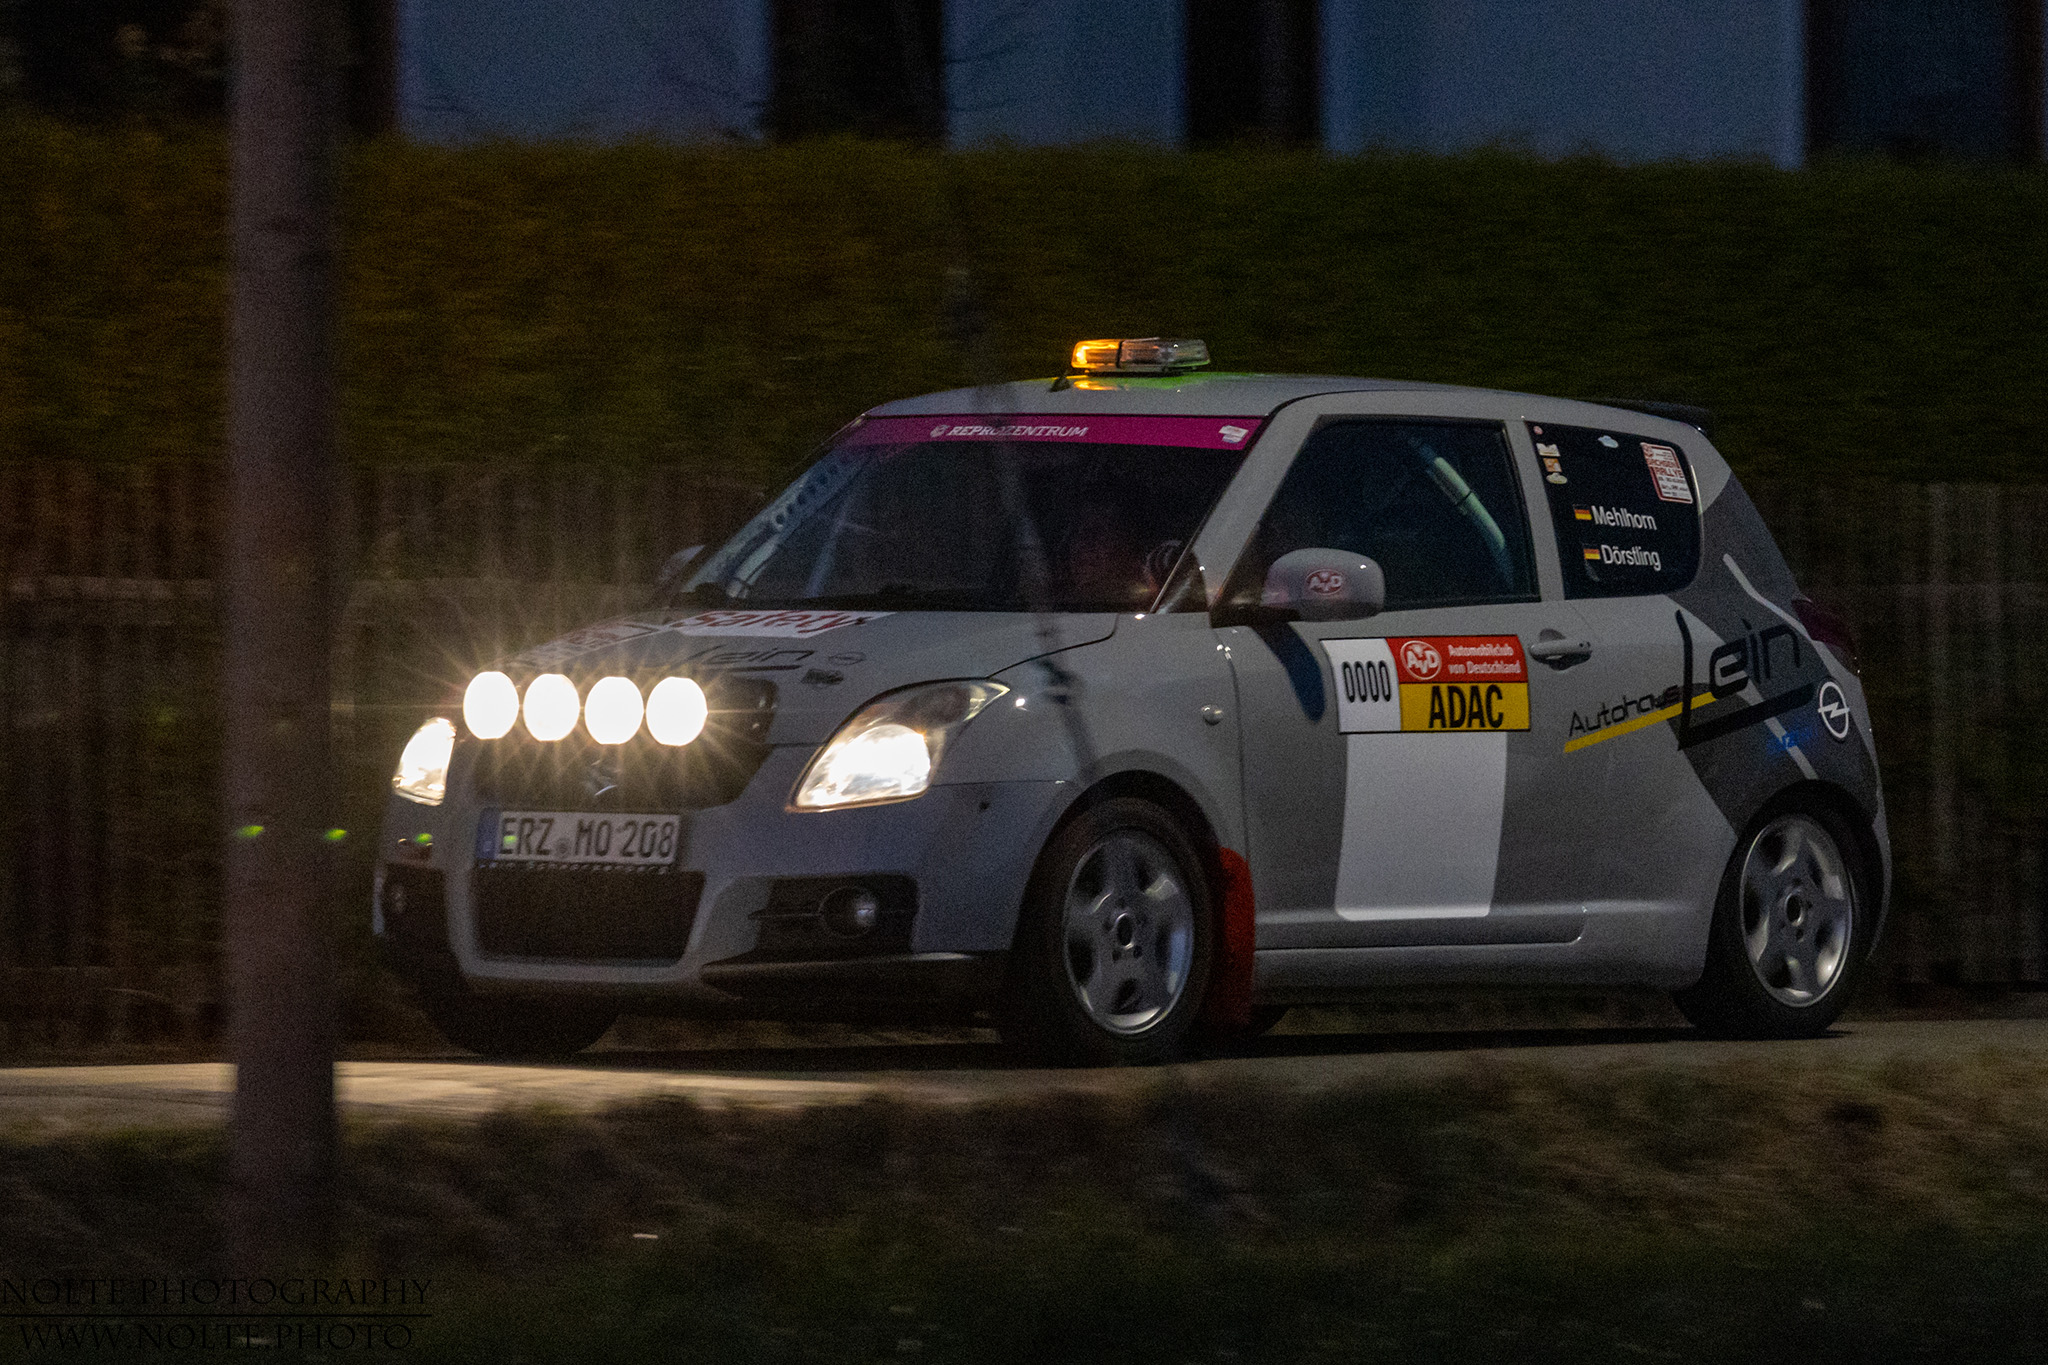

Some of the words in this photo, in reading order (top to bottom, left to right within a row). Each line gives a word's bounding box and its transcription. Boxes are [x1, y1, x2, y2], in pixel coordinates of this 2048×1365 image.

[947, 424, 1089, 438] REPROZENTRUM
[1591, 505, 1657, 531] Mehlhorn
[1600, 544, 1662, 572] Dörstling
[1448, 643, 1514, 657] Automobilclub
[1448, 663, 1466, 674] von
[1467, 659, 1522, 675] Deutschland
[1342, 660, 1391, 703] 0000
[1428, 684, 1504, 729] ADAC
[1568, 684, 1680, 737] Autohaus
[500, 817, 554, 855] ERZ
[575, 819, 611, 857] MO
[620, 819, 675, 858] 208
